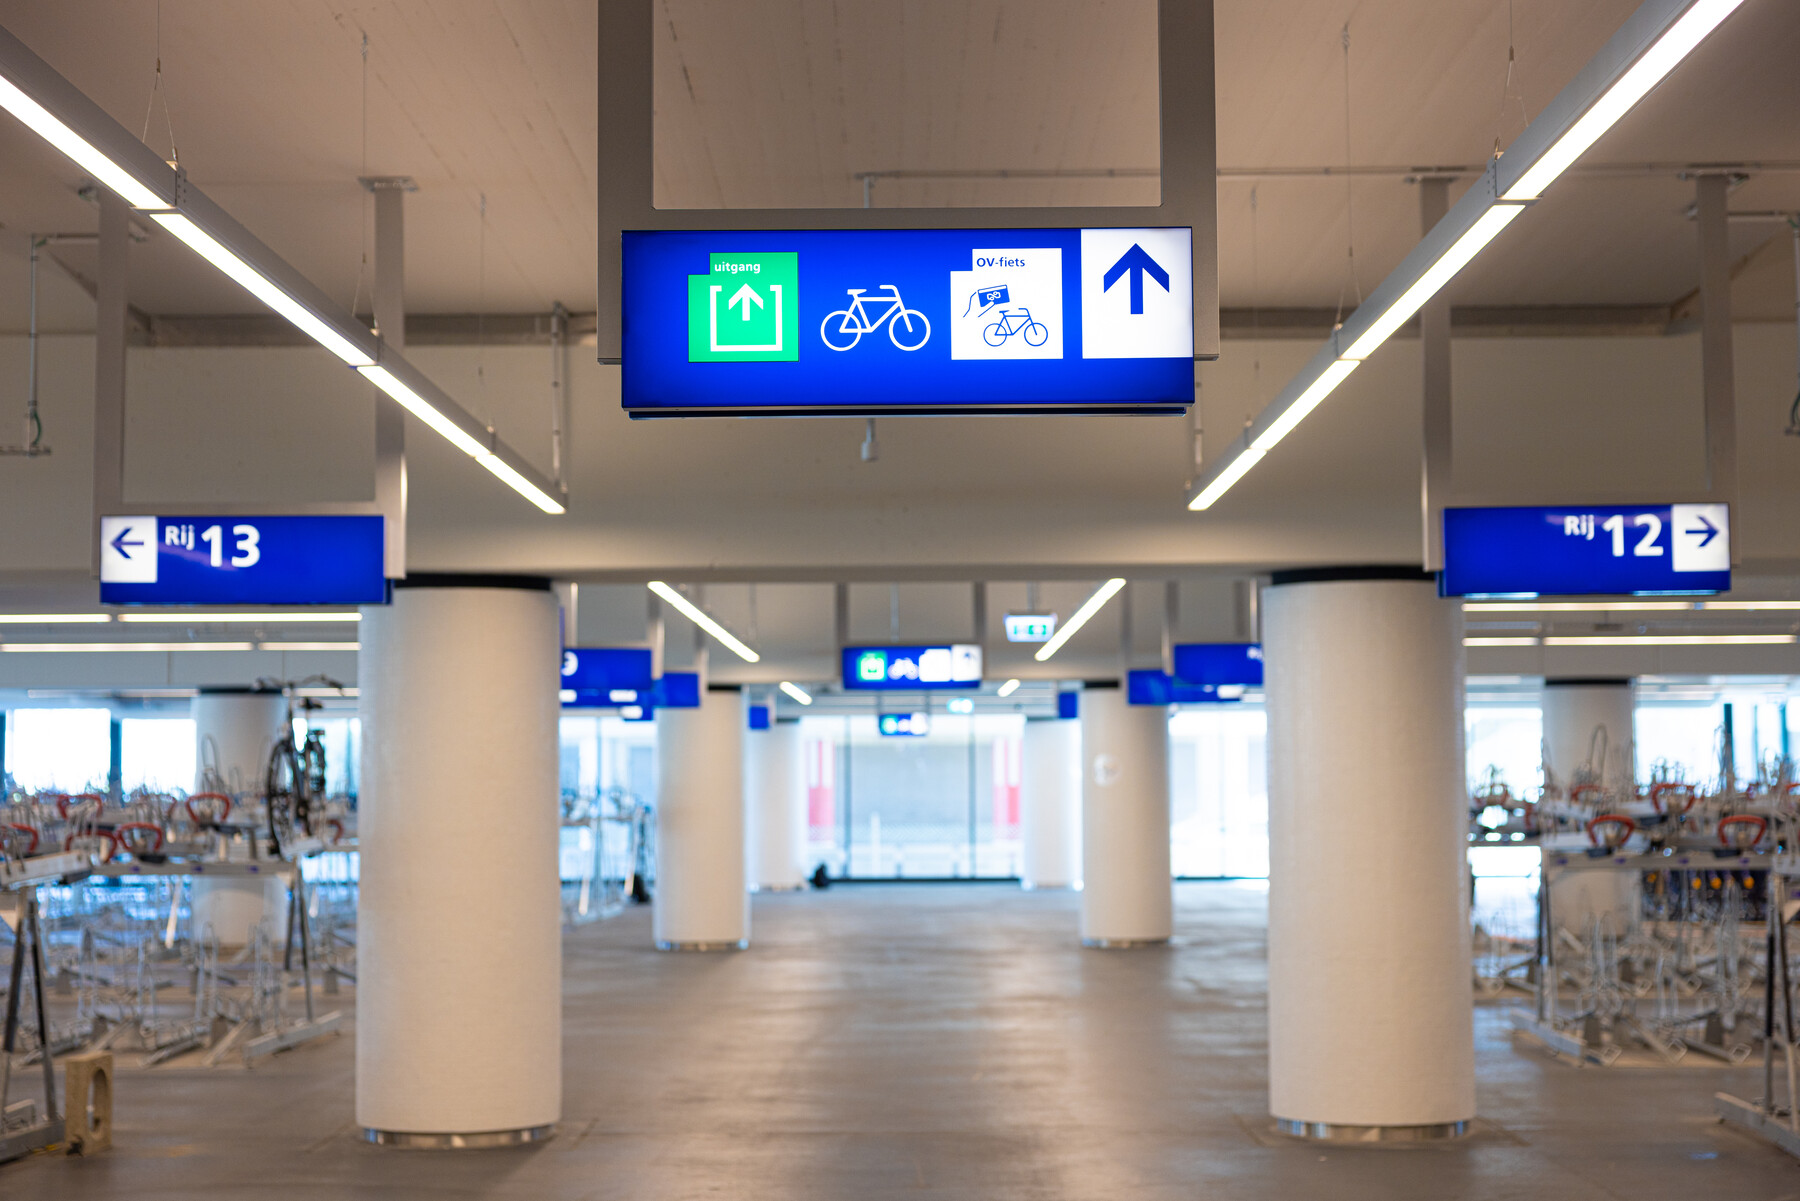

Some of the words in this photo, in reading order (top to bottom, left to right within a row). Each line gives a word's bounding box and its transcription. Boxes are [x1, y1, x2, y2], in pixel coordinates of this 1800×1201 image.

[714, 261, 761, 274] uitgang
[976, 257, 1026, 268] OV-fiets
[165, 524, 195, 551] Rij
[201, 524, 260, 568] 13
[1564, 514, 1595, 541] Rij
[1602, 513, 1664, 557] 12
